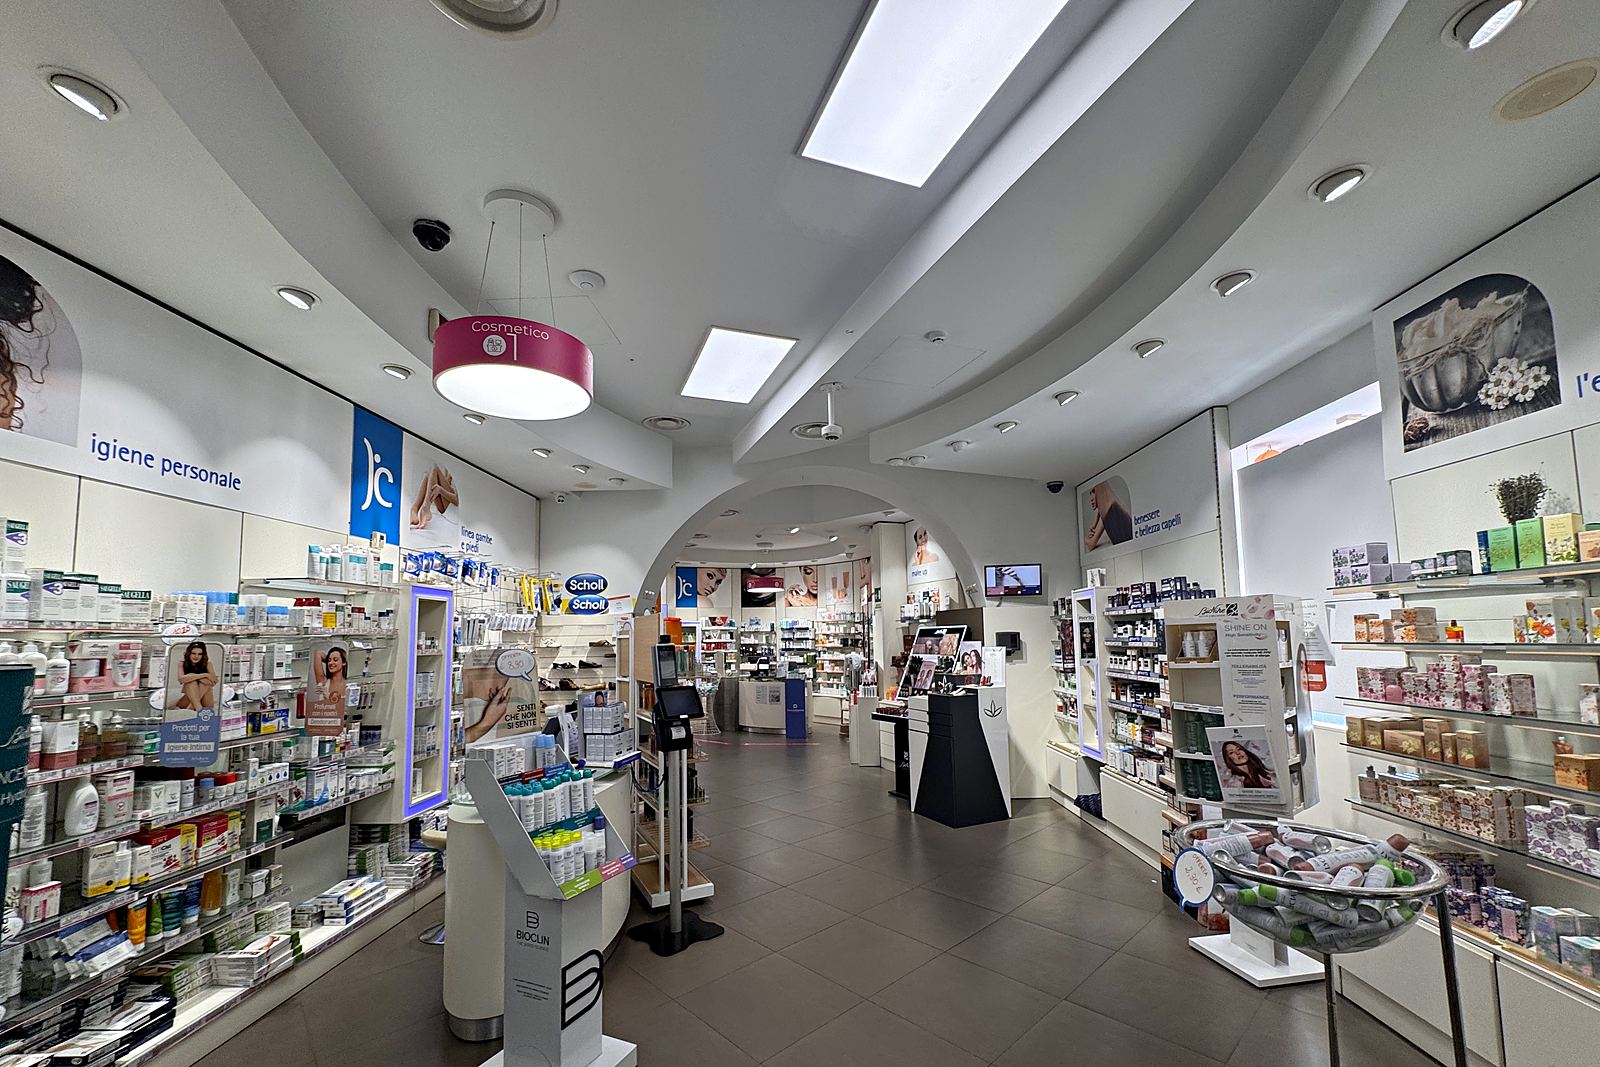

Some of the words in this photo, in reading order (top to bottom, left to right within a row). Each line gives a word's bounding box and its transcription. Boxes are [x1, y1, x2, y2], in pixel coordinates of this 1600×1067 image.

[471, 321, 549, 341] Cosmetico
[91, 432, 155, 468] igiene
[161, 456, 242, 491] personale
[1133, 509, 1160, 525] benessere
[1134, 530, 1139, 539] e
[1138, 521, 1161, 538] bellezza
[1161, 513, 1182, 532] capelli
[461, 525, 475, 539] linea
[475, 532, 493, 545] gambe
[461, 541, 465, 550] e
[465, 541, 480, 553] piedi
[569, 578, 604, 590] Scholl
[572, 598, 606, 610] Scholl
[1224, 623, 1251, 632] SHINE
[1253, 623, 1268, 631] ON
[516, 703, 537, 713] SENTI
[504, 712, 520, 722] CHE
[521, 710, 537, 720] NON
[171, 723, 198, 733] Prodotti
[198, 724, 210, 733] per
[507, 722, 514, 730] SI
[515, 719, 537, 729] SENTE
[180, 733, 187, 741] la
[1192, 853, 1209, 877] OFFERTA
[516, 929, 550, 946] BIOCLIN
